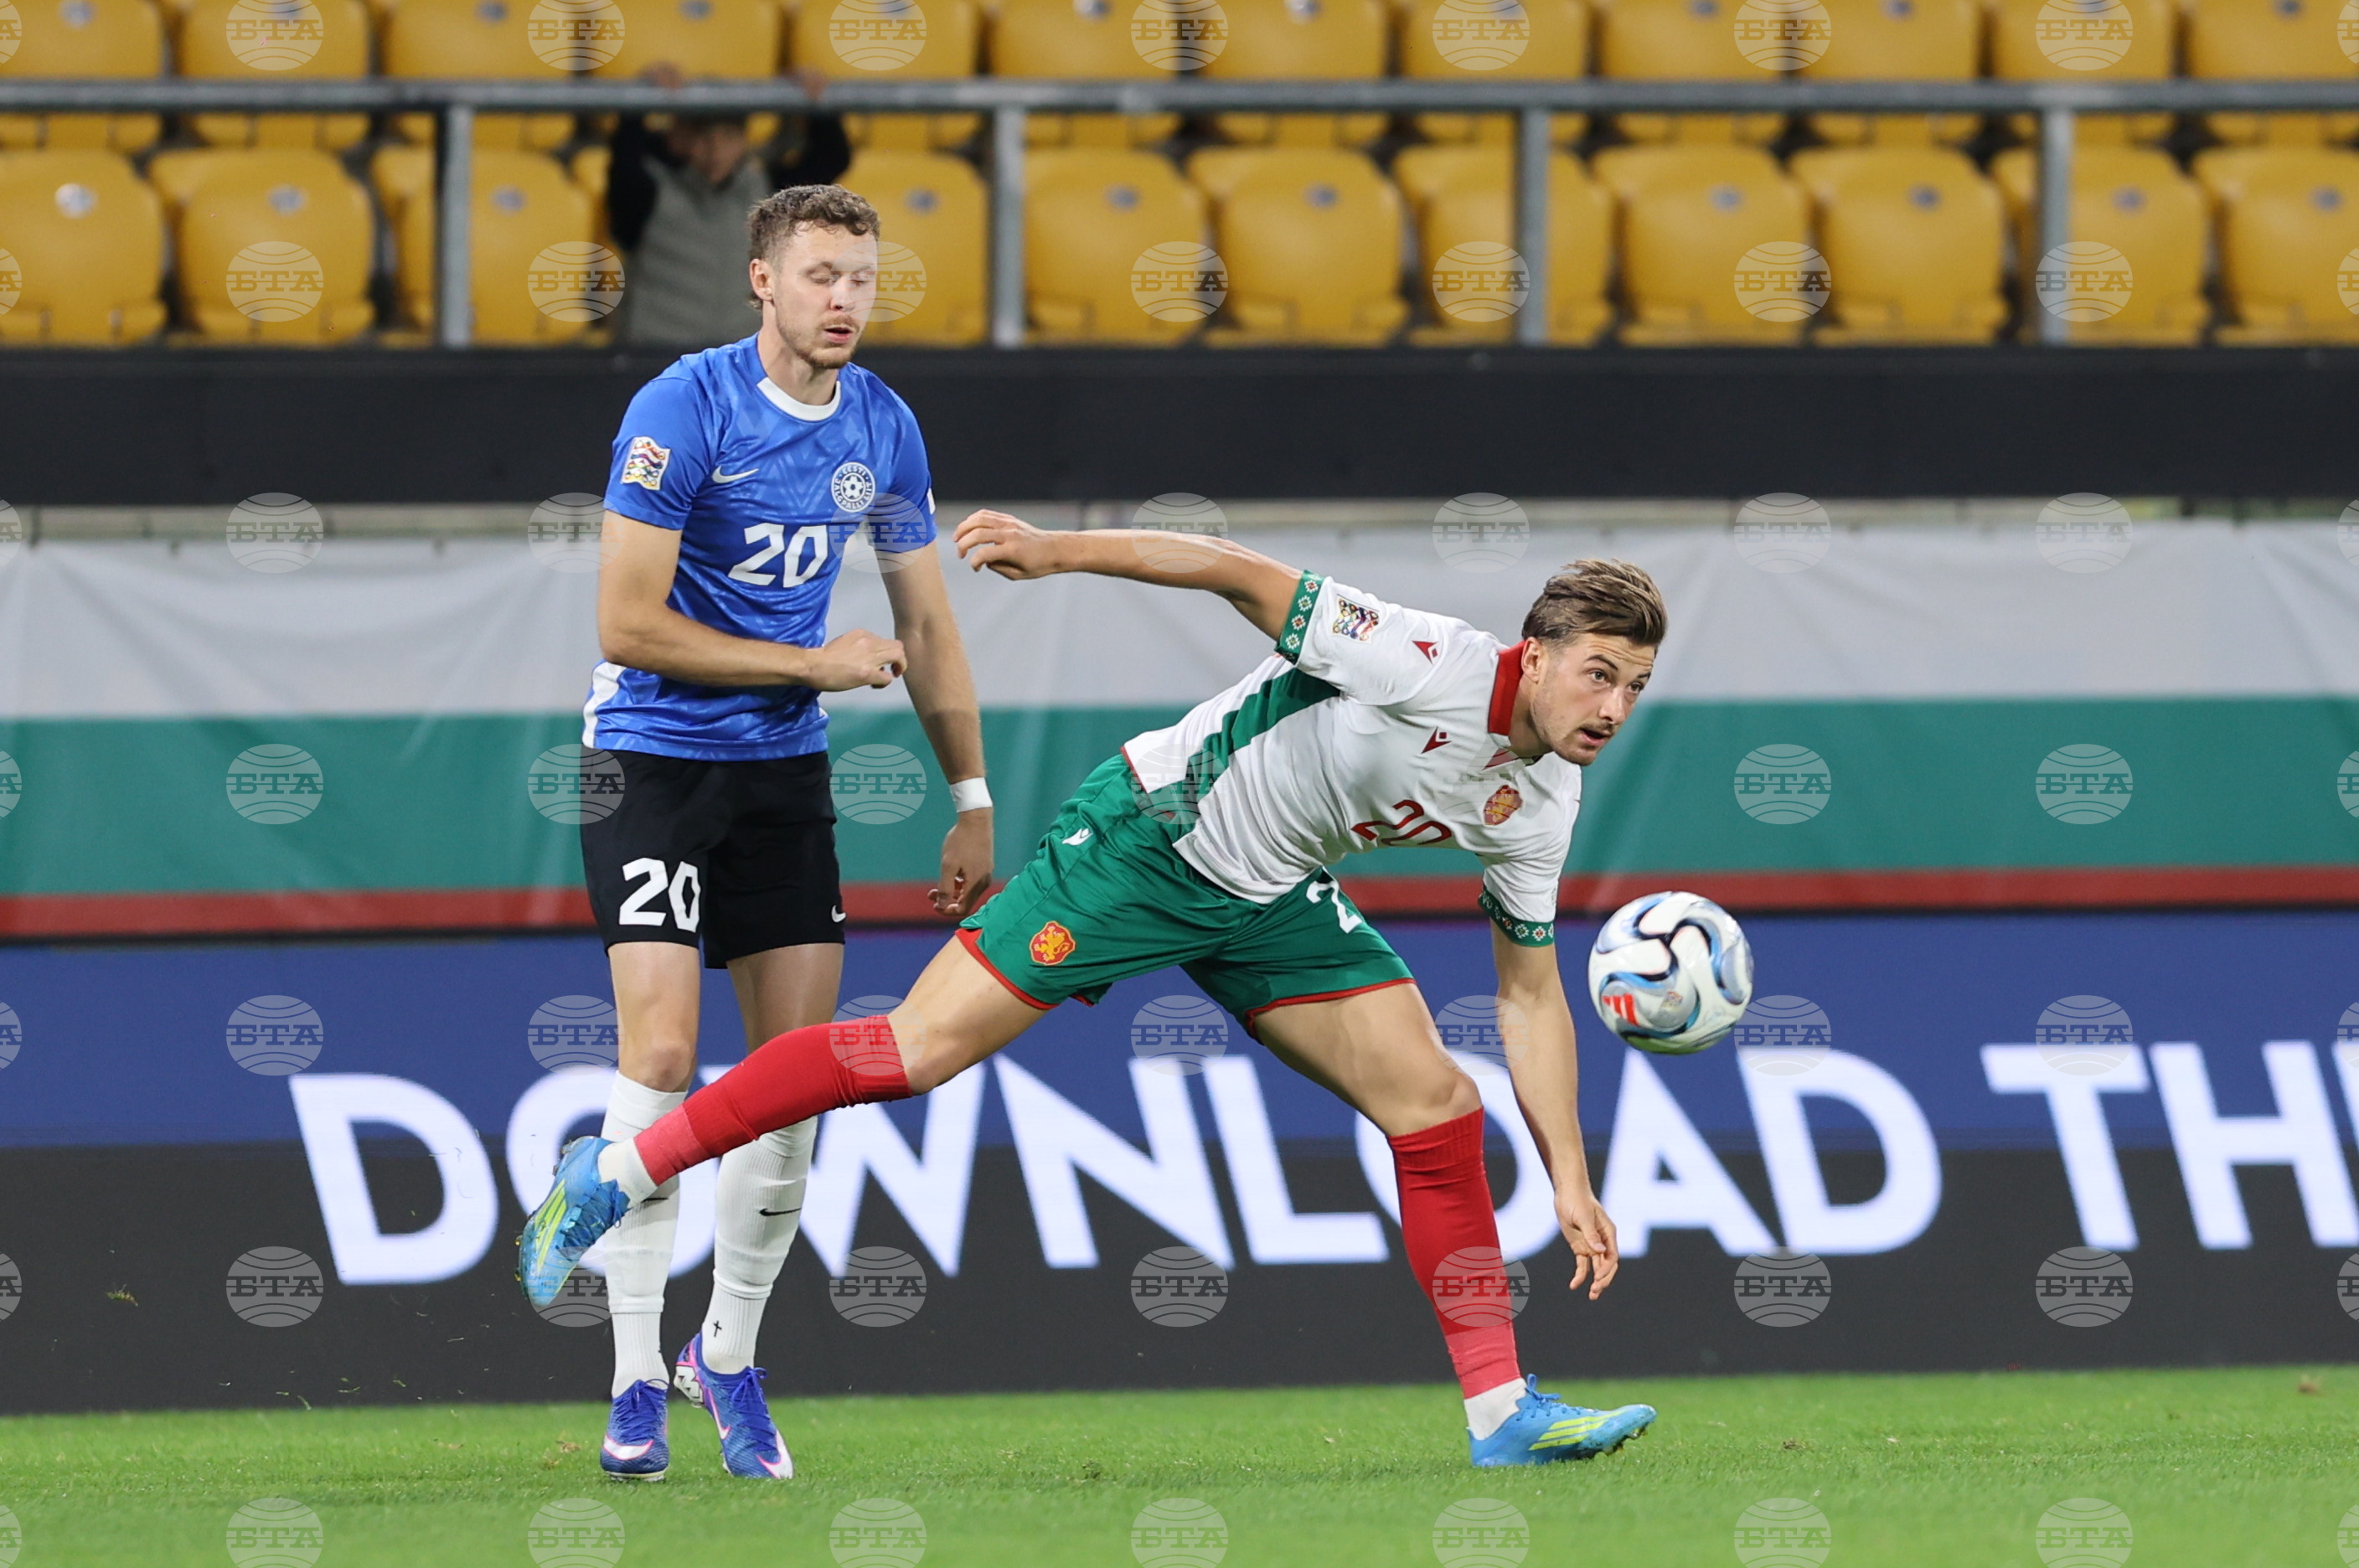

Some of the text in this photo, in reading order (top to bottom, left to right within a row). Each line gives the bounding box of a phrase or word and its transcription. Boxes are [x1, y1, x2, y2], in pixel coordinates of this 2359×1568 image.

[728, 523, 828, 588] 20
[1350, 799, 1452, 846] 20
[618, 857, 701, 933] 20
[289, 1041, 2359, 1285] DOWNLOAD TH
